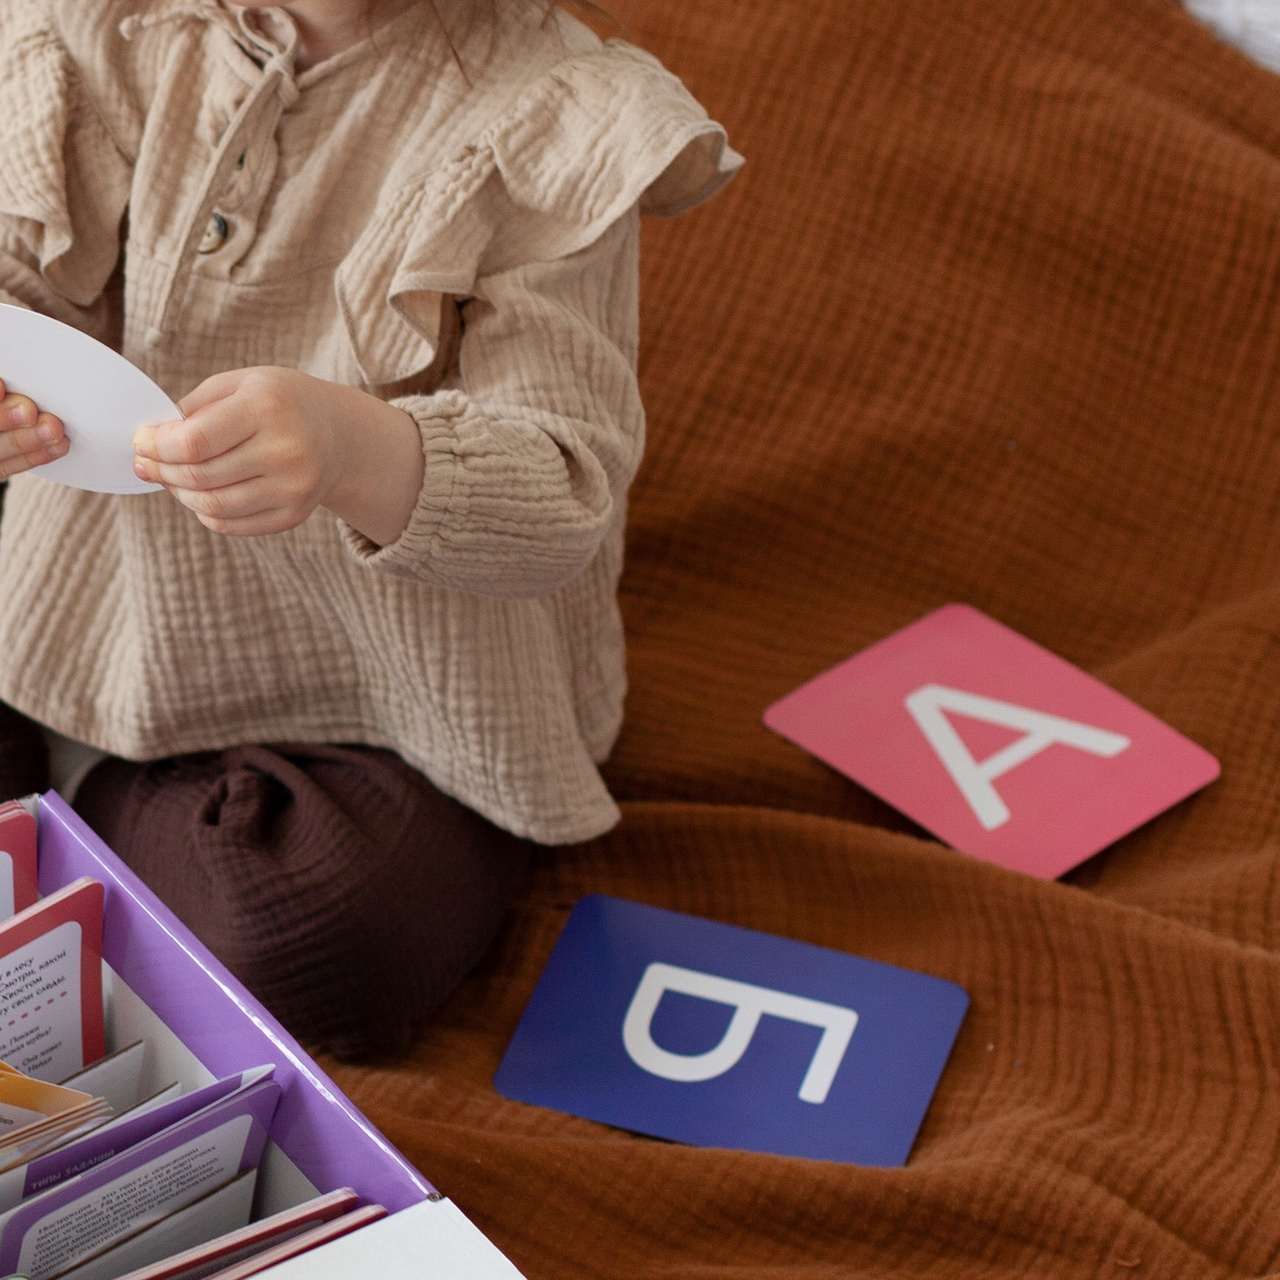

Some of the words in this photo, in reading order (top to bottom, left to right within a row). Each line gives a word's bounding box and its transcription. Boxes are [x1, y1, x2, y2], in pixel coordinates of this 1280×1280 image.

[905, 684, 1131, 830] А
[14, 958, 33, 972] лесу
[39, 951, 66, 970] какой
[2, 976, 42, 1002] Хвостом
[12, 994, 33, 1009] свои
[36, 976, 65, 995] следы.
[623, 962, 859, 1104] Б
